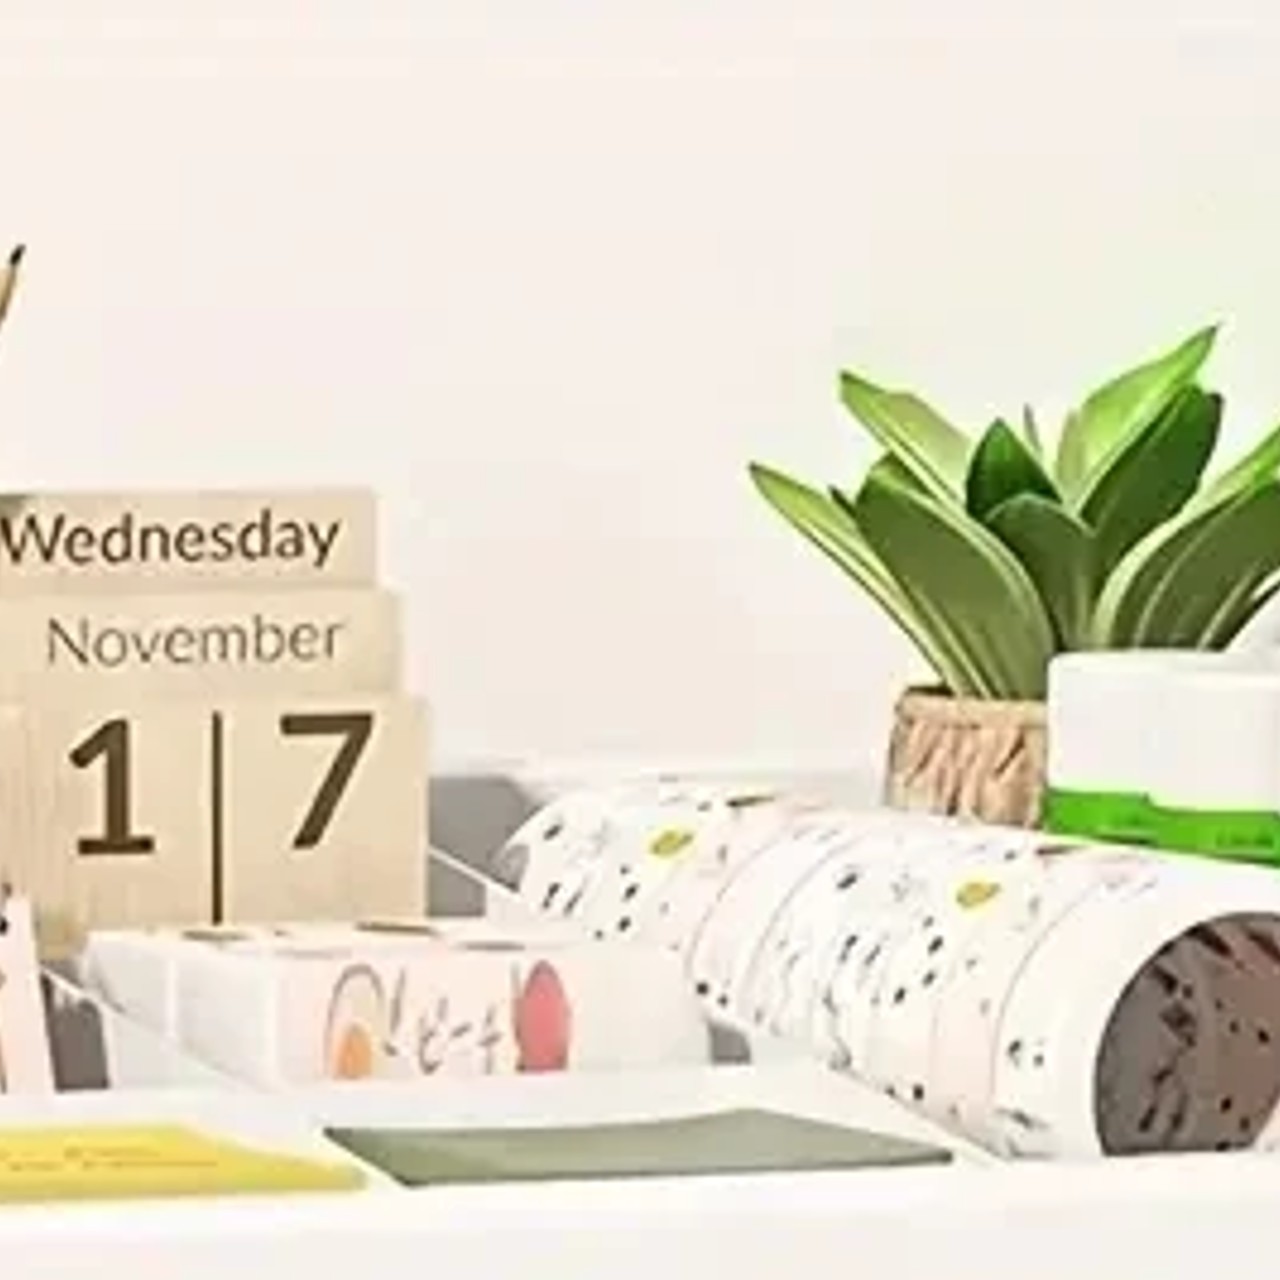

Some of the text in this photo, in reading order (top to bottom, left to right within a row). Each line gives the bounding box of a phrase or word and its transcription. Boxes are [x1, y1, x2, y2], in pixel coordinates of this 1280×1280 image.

[0, 508, 342, 569] Wednesday
[46, 613, 346, 668] November
[67, 711, 376, 857] 1 7
